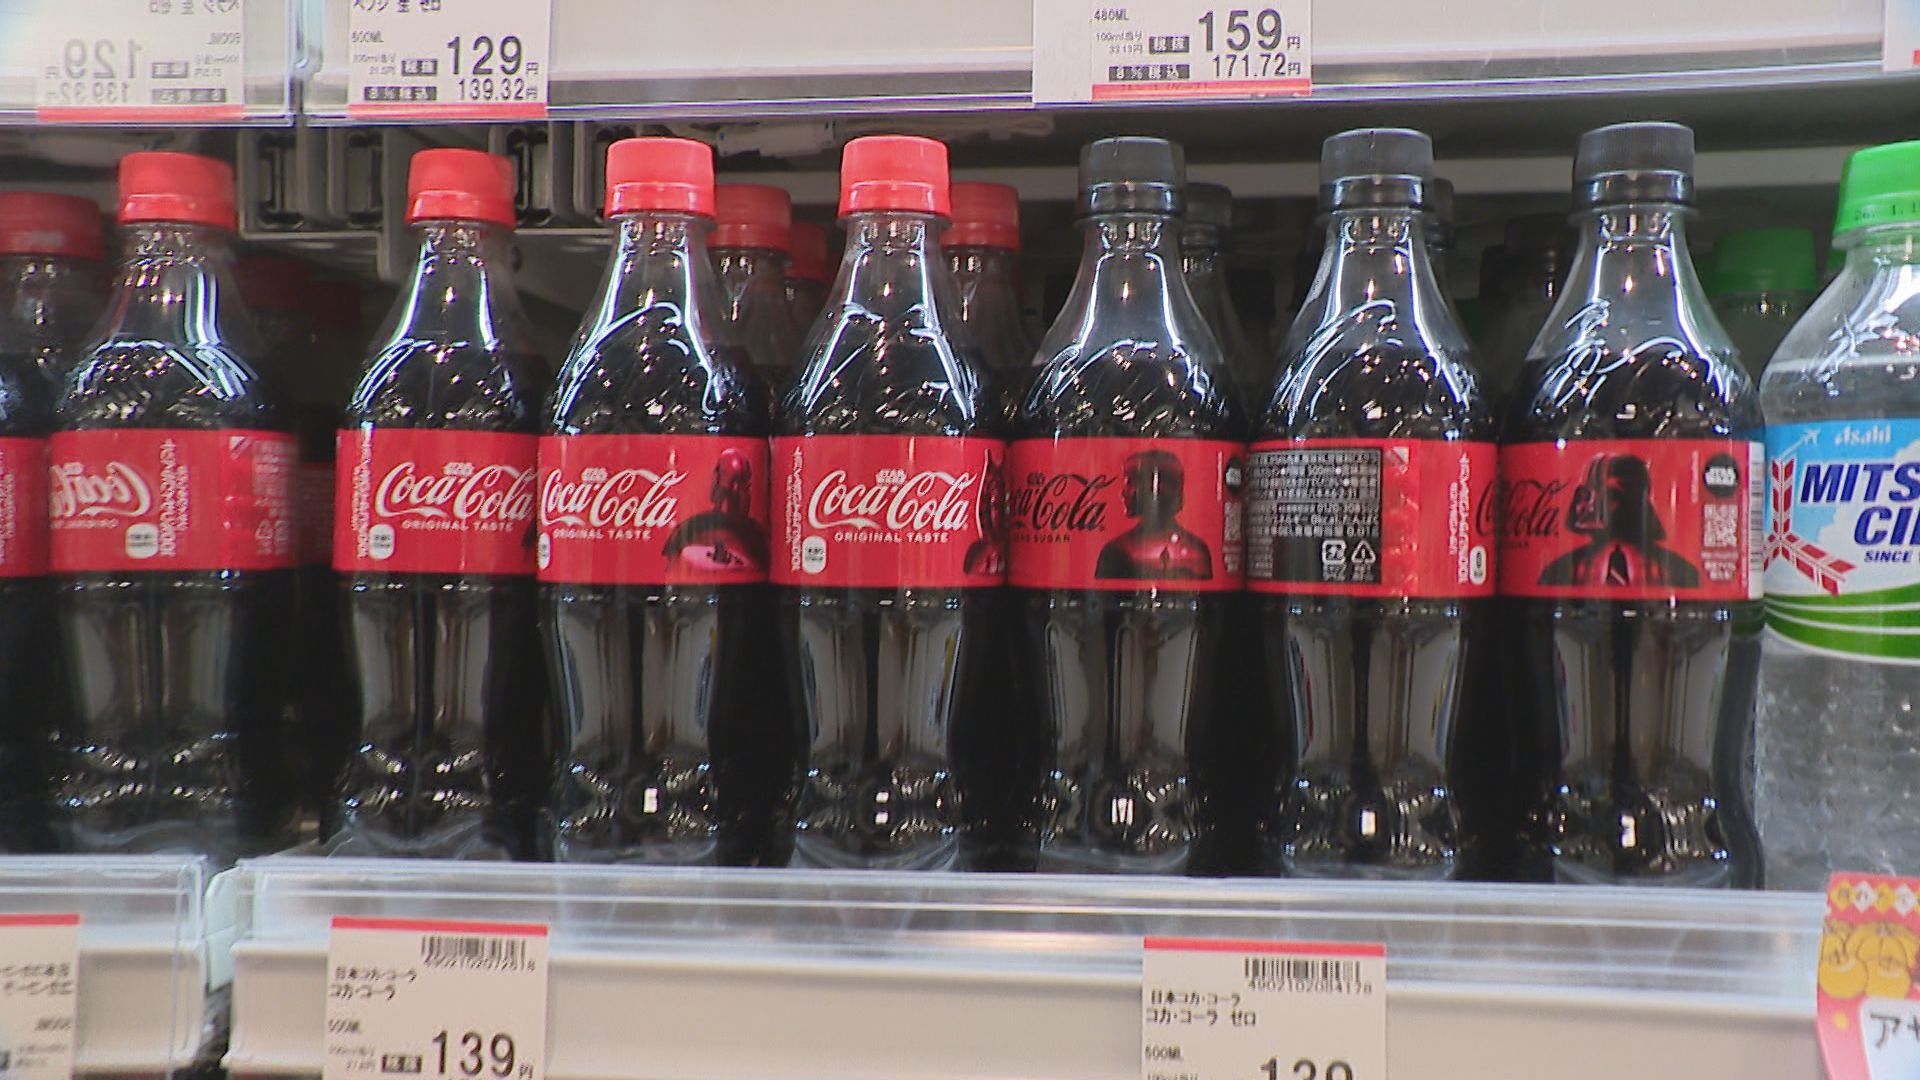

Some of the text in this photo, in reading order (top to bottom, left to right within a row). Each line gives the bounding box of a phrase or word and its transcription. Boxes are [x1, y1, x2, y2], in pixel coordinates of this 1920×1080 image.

[1094, 8, 1129, 21] 480ML
[402, 519, 513, 532] ORIGINAL TASTE
[1854, 507, 1920, 545] CI
[553, 528, 651, 540] ORIGINAL TASTE
[834, 531, 949, 544] ORIGINAL TASTE
[1863, 551, 1912, 563] SINCE
[1151, 990, 1241, 1007] 日本コカ・コーラ
[1146, 1007, 1257, 1027] コカ・コーラ ゼロ
